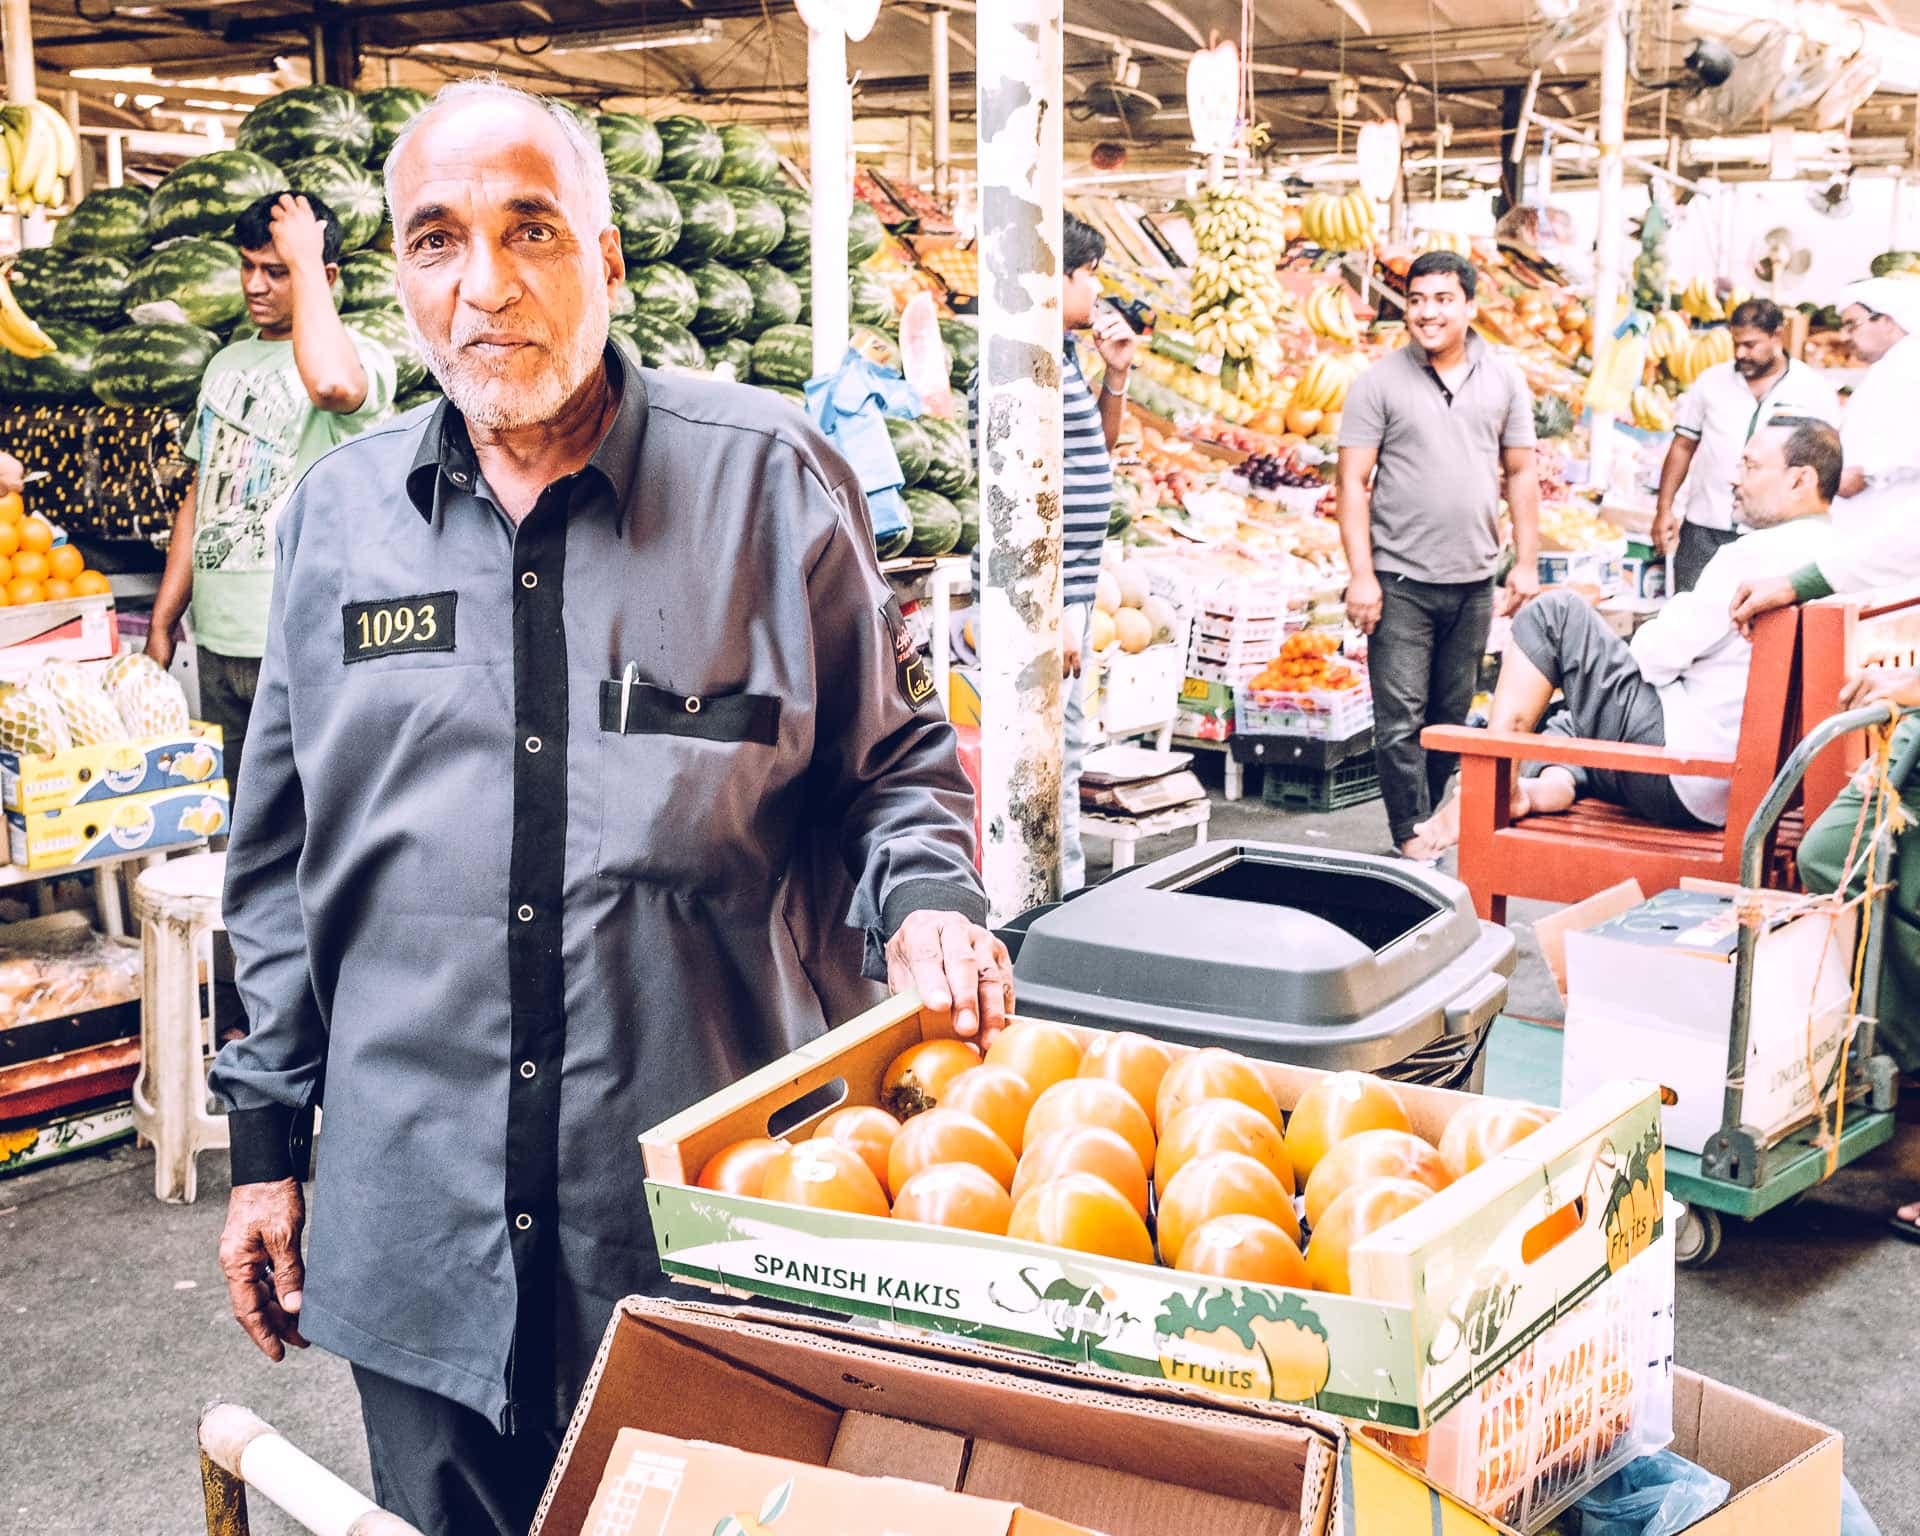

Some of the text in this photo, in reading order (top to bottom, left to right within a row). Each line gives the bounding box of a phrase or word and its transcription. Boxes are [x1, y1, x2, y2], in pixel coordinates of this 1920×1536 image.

[357, 604, 437, 649] 1093
[754, 1253, 961, 1310] SPANISH KAKIS
[1172, 1353, 1253, 1390] Fruits
